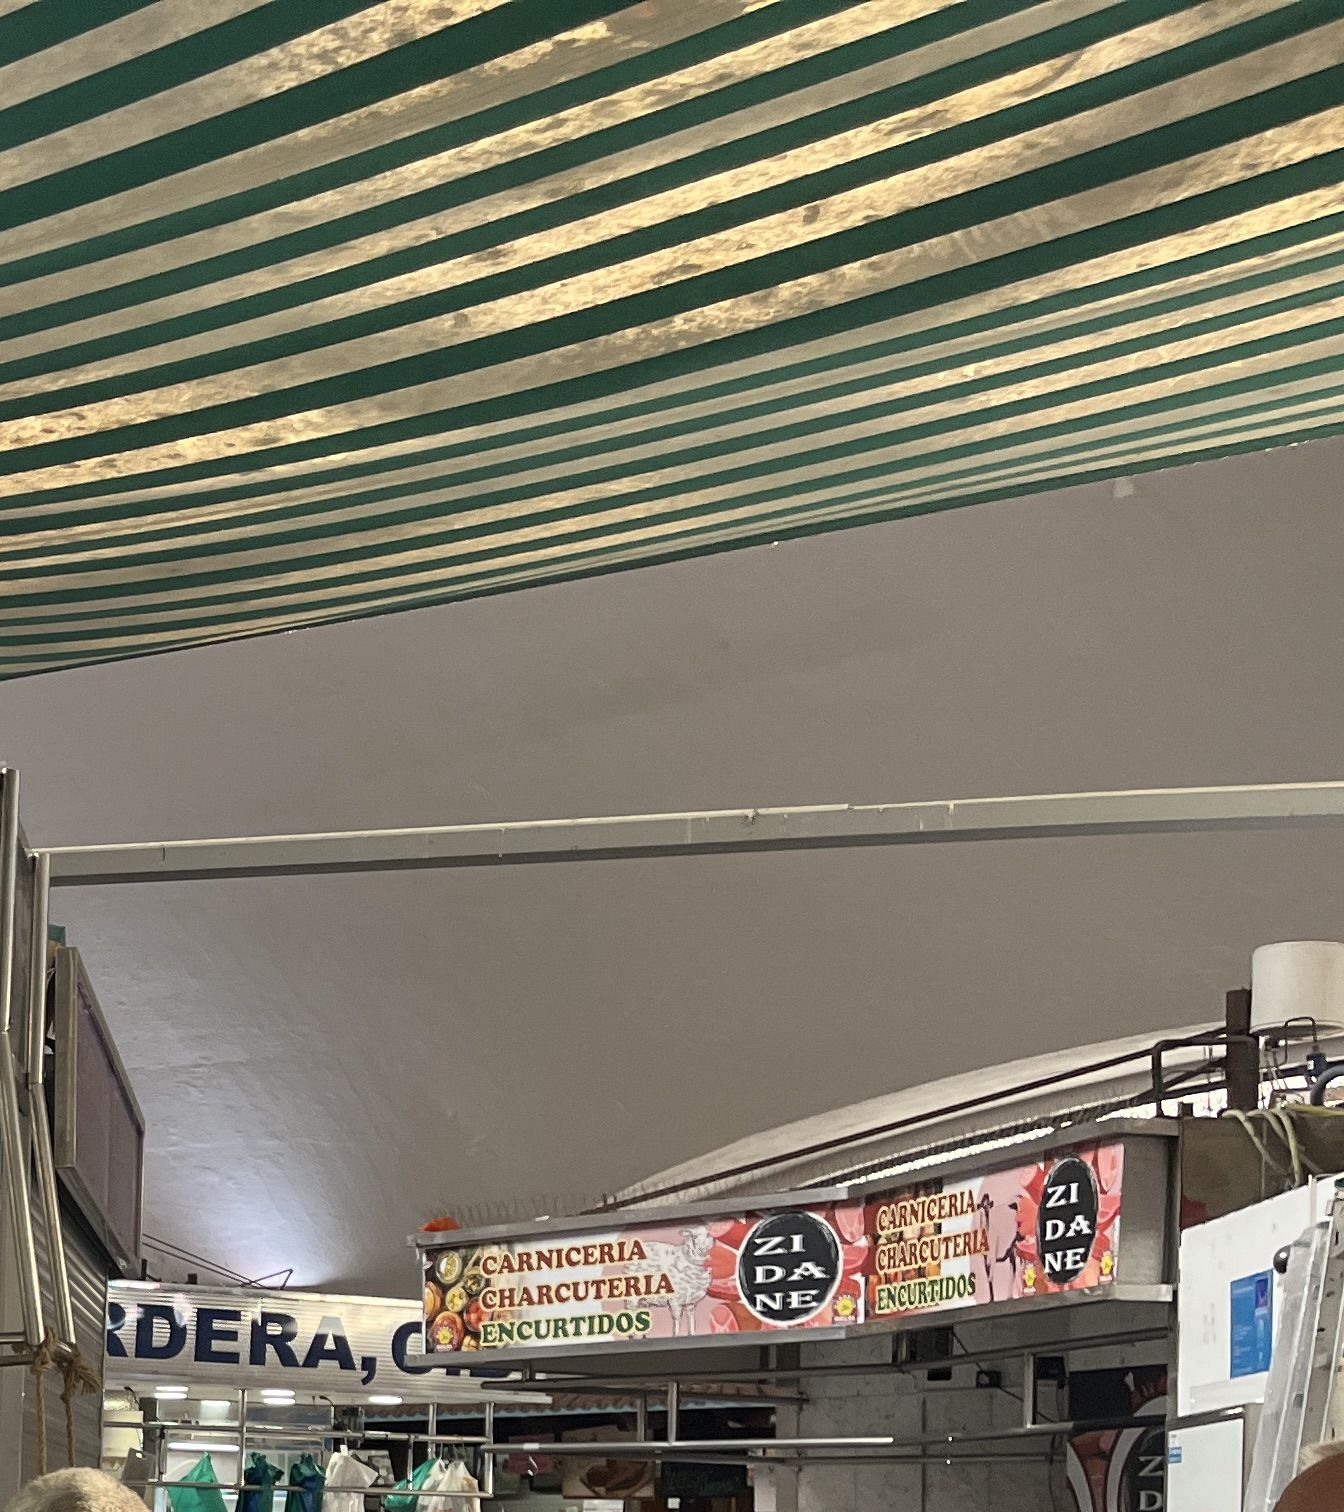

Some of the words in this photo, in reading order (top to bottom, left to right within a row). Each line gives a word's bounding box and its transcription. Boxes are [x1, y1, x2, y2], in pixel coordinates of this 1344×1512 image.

[877, 1188, 976, 1233] CARNICERIA
[1045, 1182, 1080, 1209] ZI
[1045, 1214, 1092, 1241] DA
[481, 1238, 649, 1277] CARNICERIA
[753, 1234, 805, 1257] ZI
[877, 1228, 989, 1272] CHARCUTERIA
[1044, 1247, 1086, 1274] NE
[754, 1261, 830, 1284] DA
[479, 1272, 676, 1311] CHARCUTERIA
[755, 1289, 822, 1313] NE
[876, 1272, 976, 1312] ENCURTIDOS
[480, 1310, 653, 1347] ENCURTIDOS
